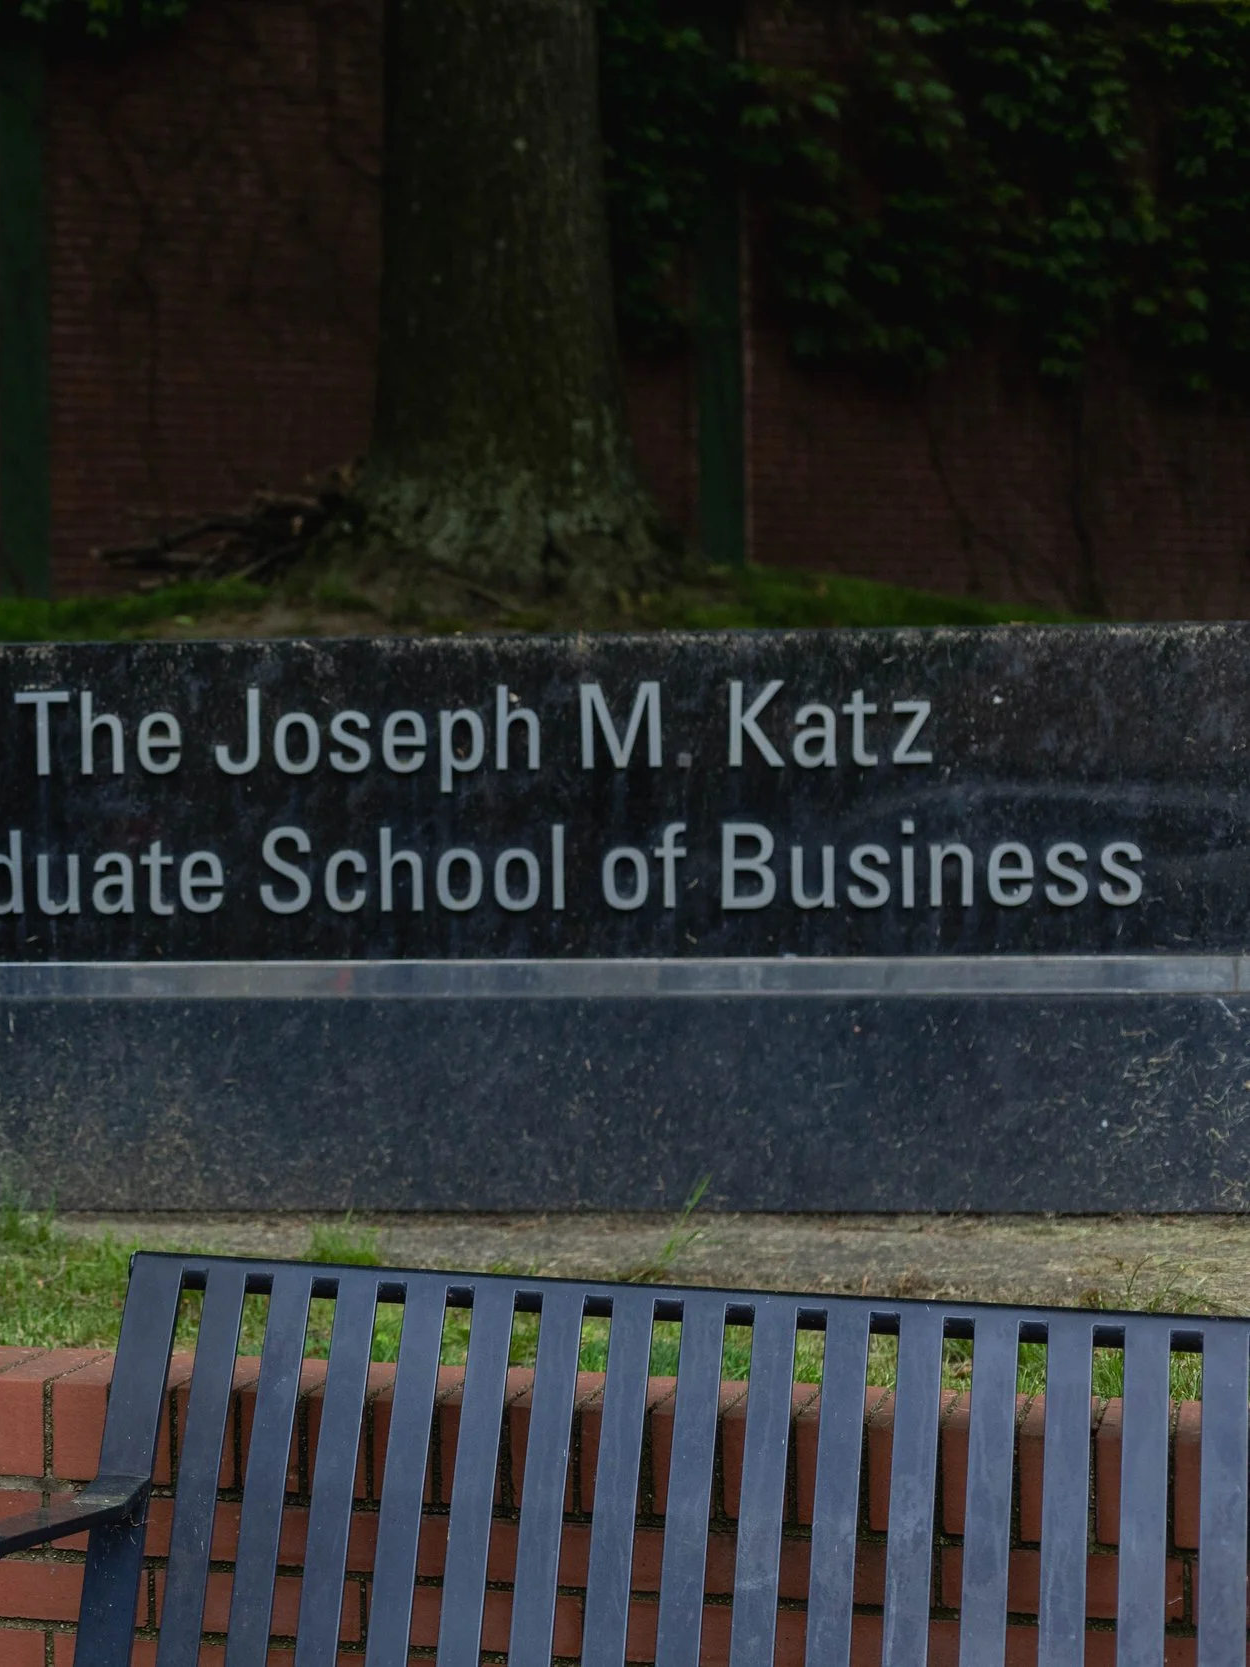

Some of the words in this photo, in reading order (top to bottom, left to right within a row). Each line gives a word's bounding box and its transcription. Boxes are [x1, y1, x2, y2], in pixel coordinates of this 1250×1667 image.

[15, 691, 181, 775] The
[215, 684, 540, 792] Joseph
[580, 681, 692, 768] M.
[729, 679, 933, 767] Katz
[260, 824, 564, 913] School
[603, 822, 687, 910] of
[721, 820, 1143, 910] Business
